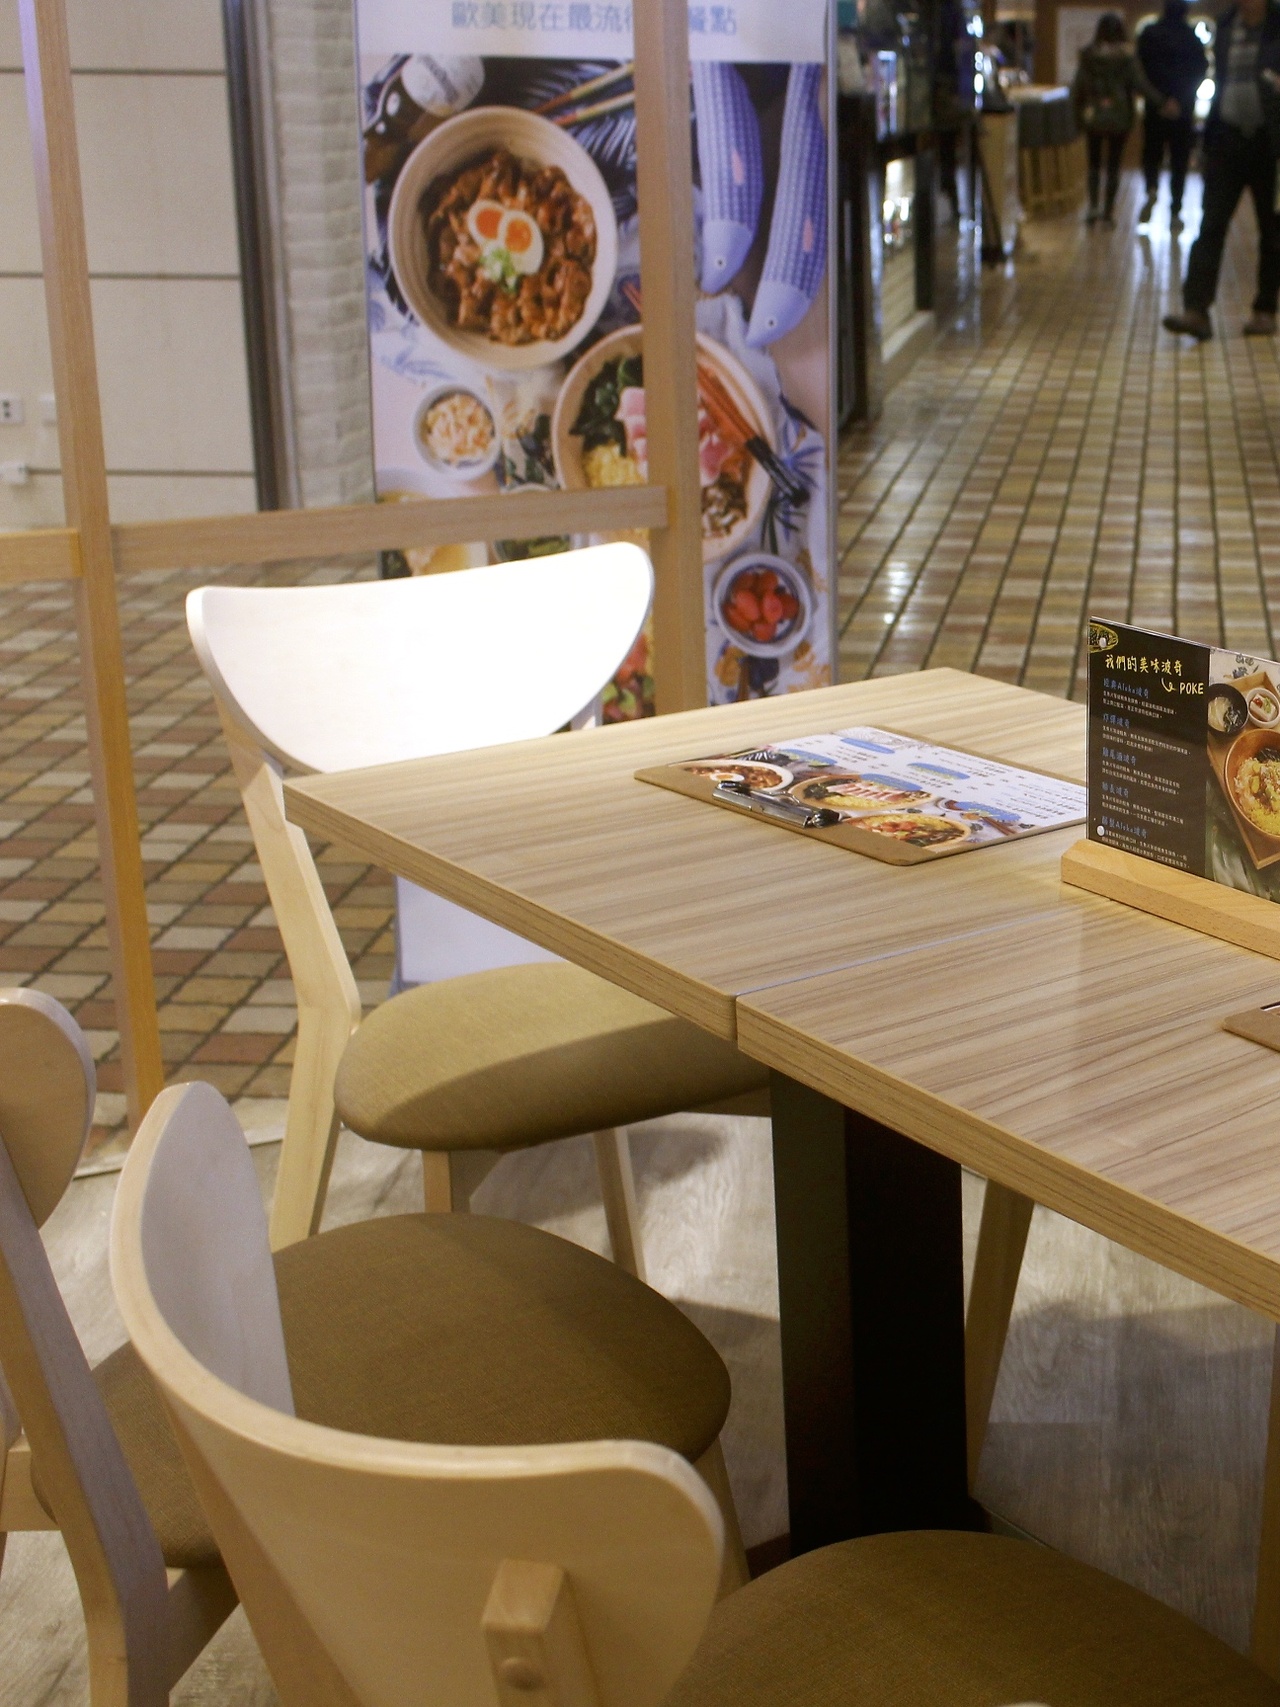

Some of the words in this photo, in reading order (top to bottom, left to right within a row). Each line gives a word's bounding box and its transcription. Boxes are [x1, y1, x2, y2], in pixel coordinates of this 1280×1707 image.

[451, 2, 737, 35] 歐美現在最流餐點
[1105, 653, 1183, 677] 我們的美味波奇
[1180, 681, 1204, 695] POKE
